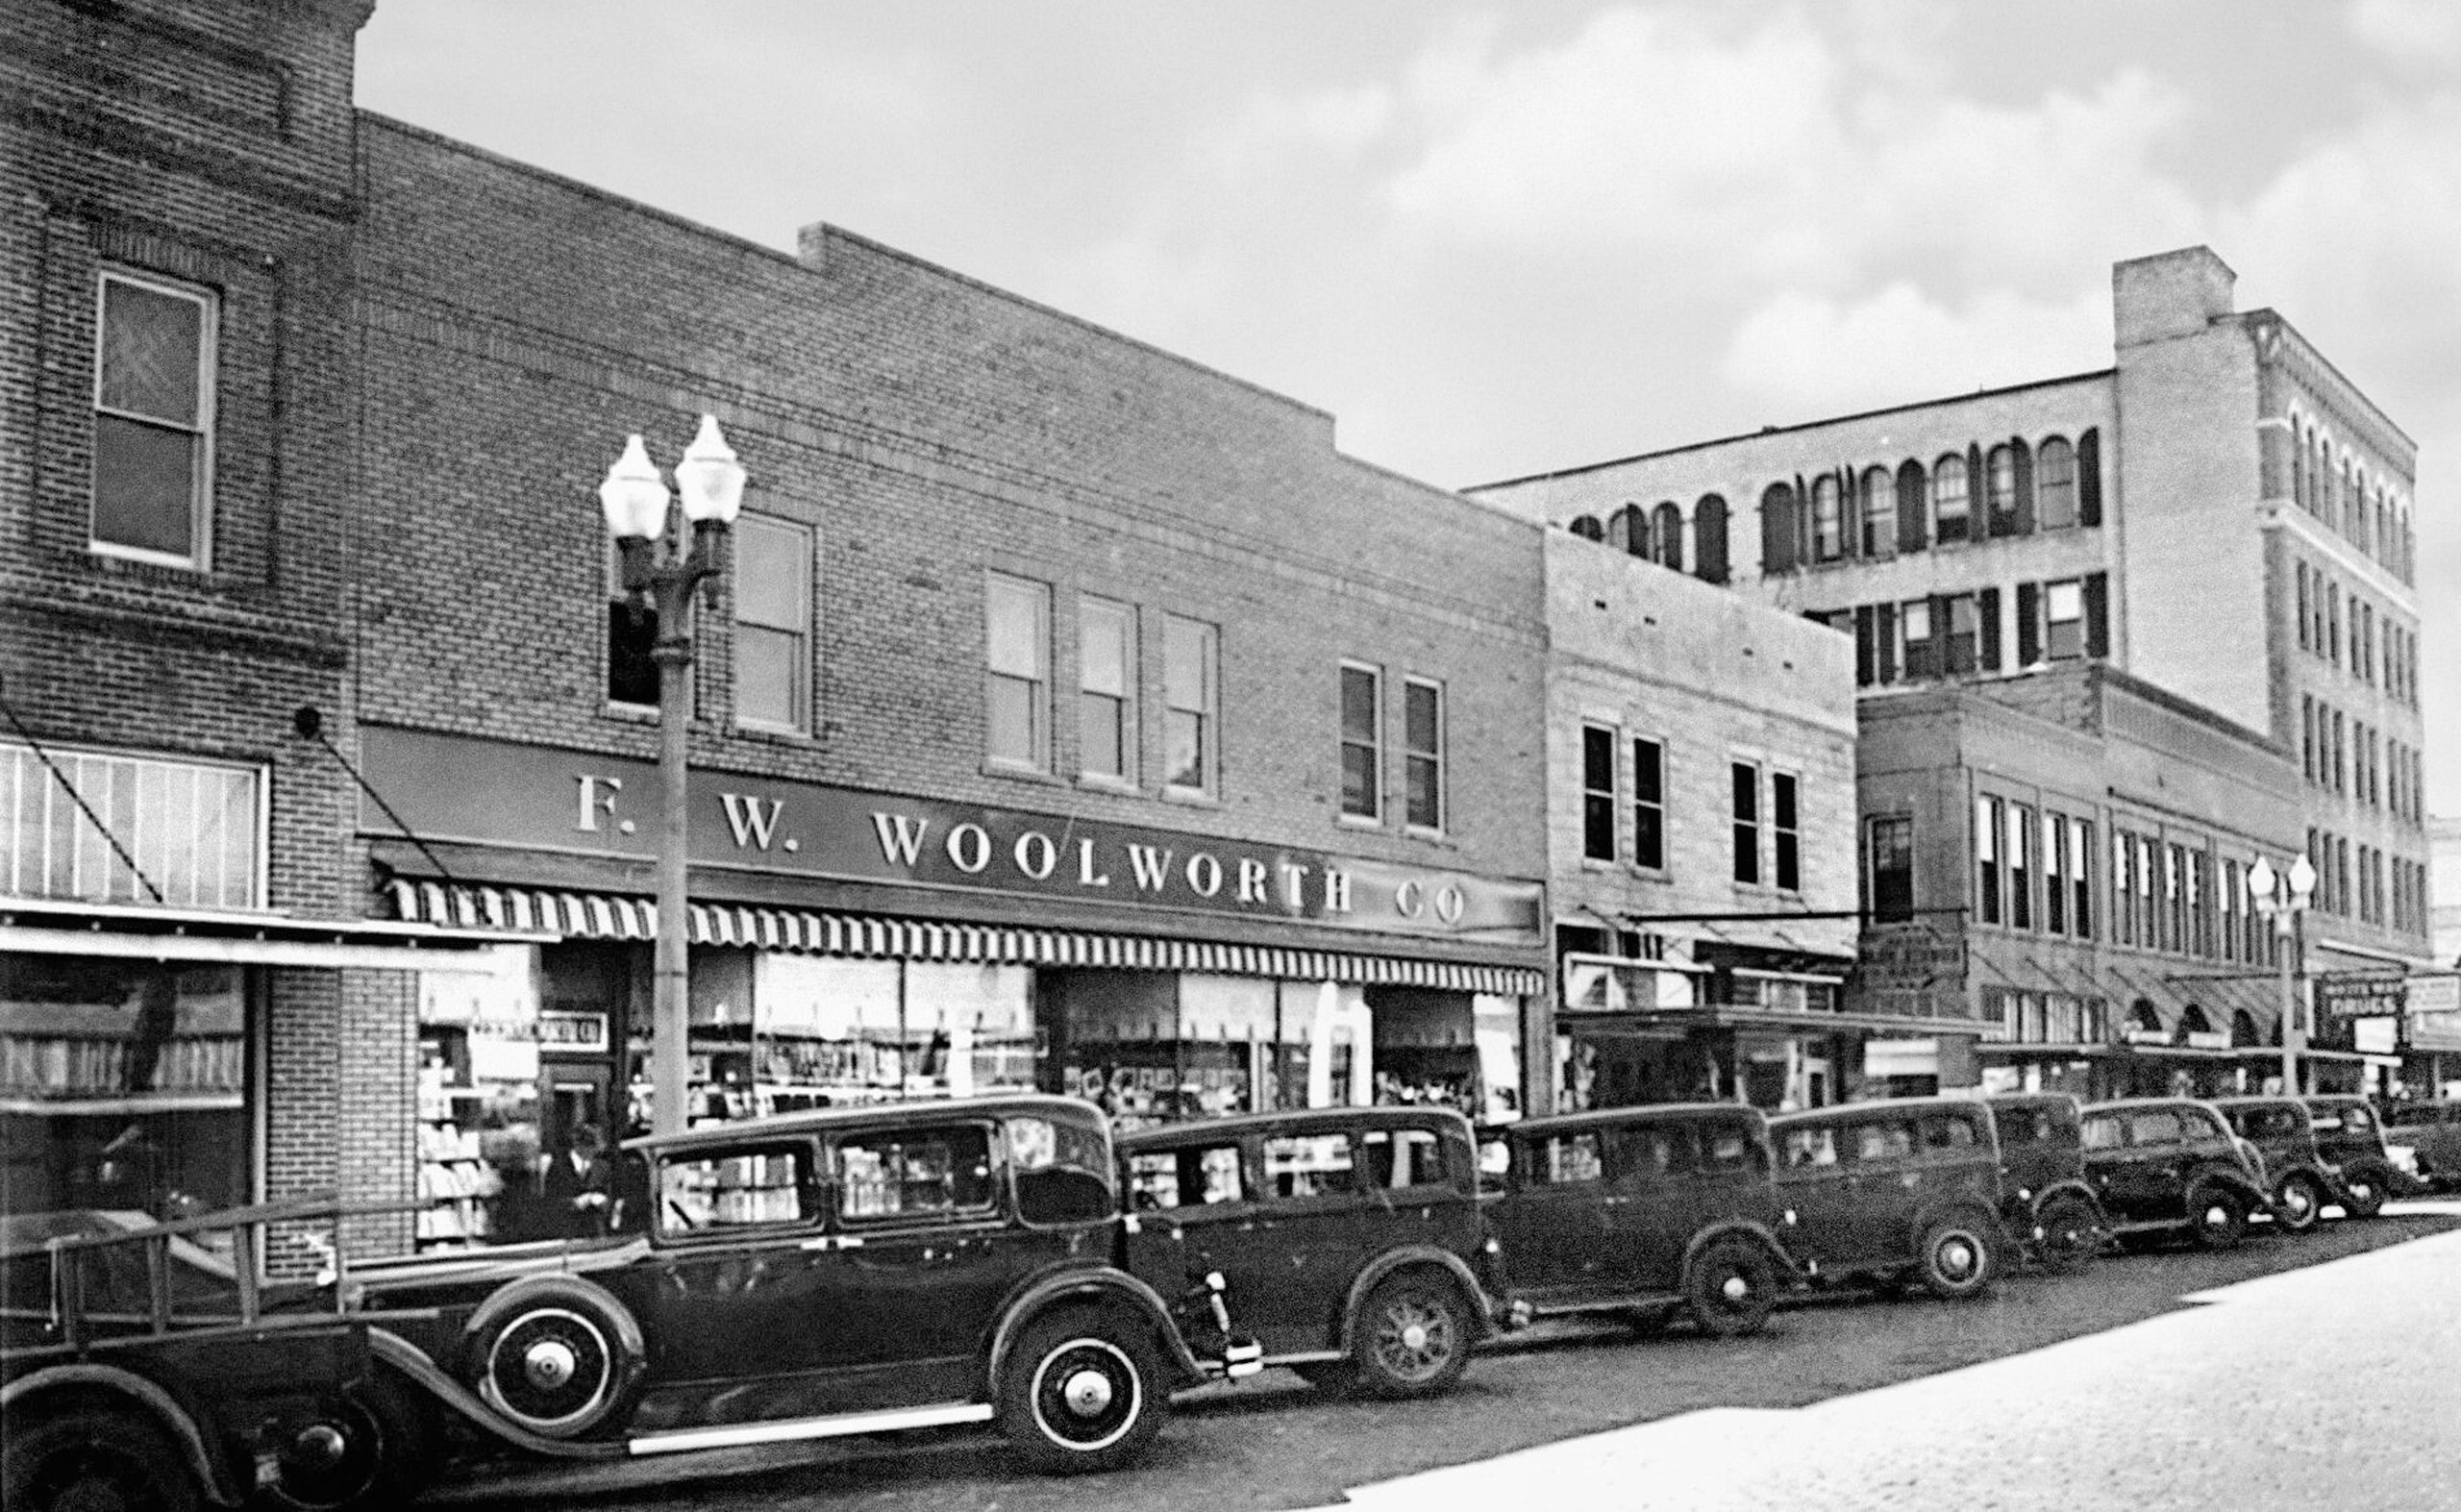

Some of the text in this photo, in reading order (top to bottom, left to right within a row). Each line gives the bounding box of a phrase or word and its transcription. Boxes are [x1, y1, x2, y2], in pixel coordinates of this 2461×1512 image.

[575, 774, 1465, 923] F. W. WOOLWORTH CO
[2330, 996, 2398, 1015] DRUGS
